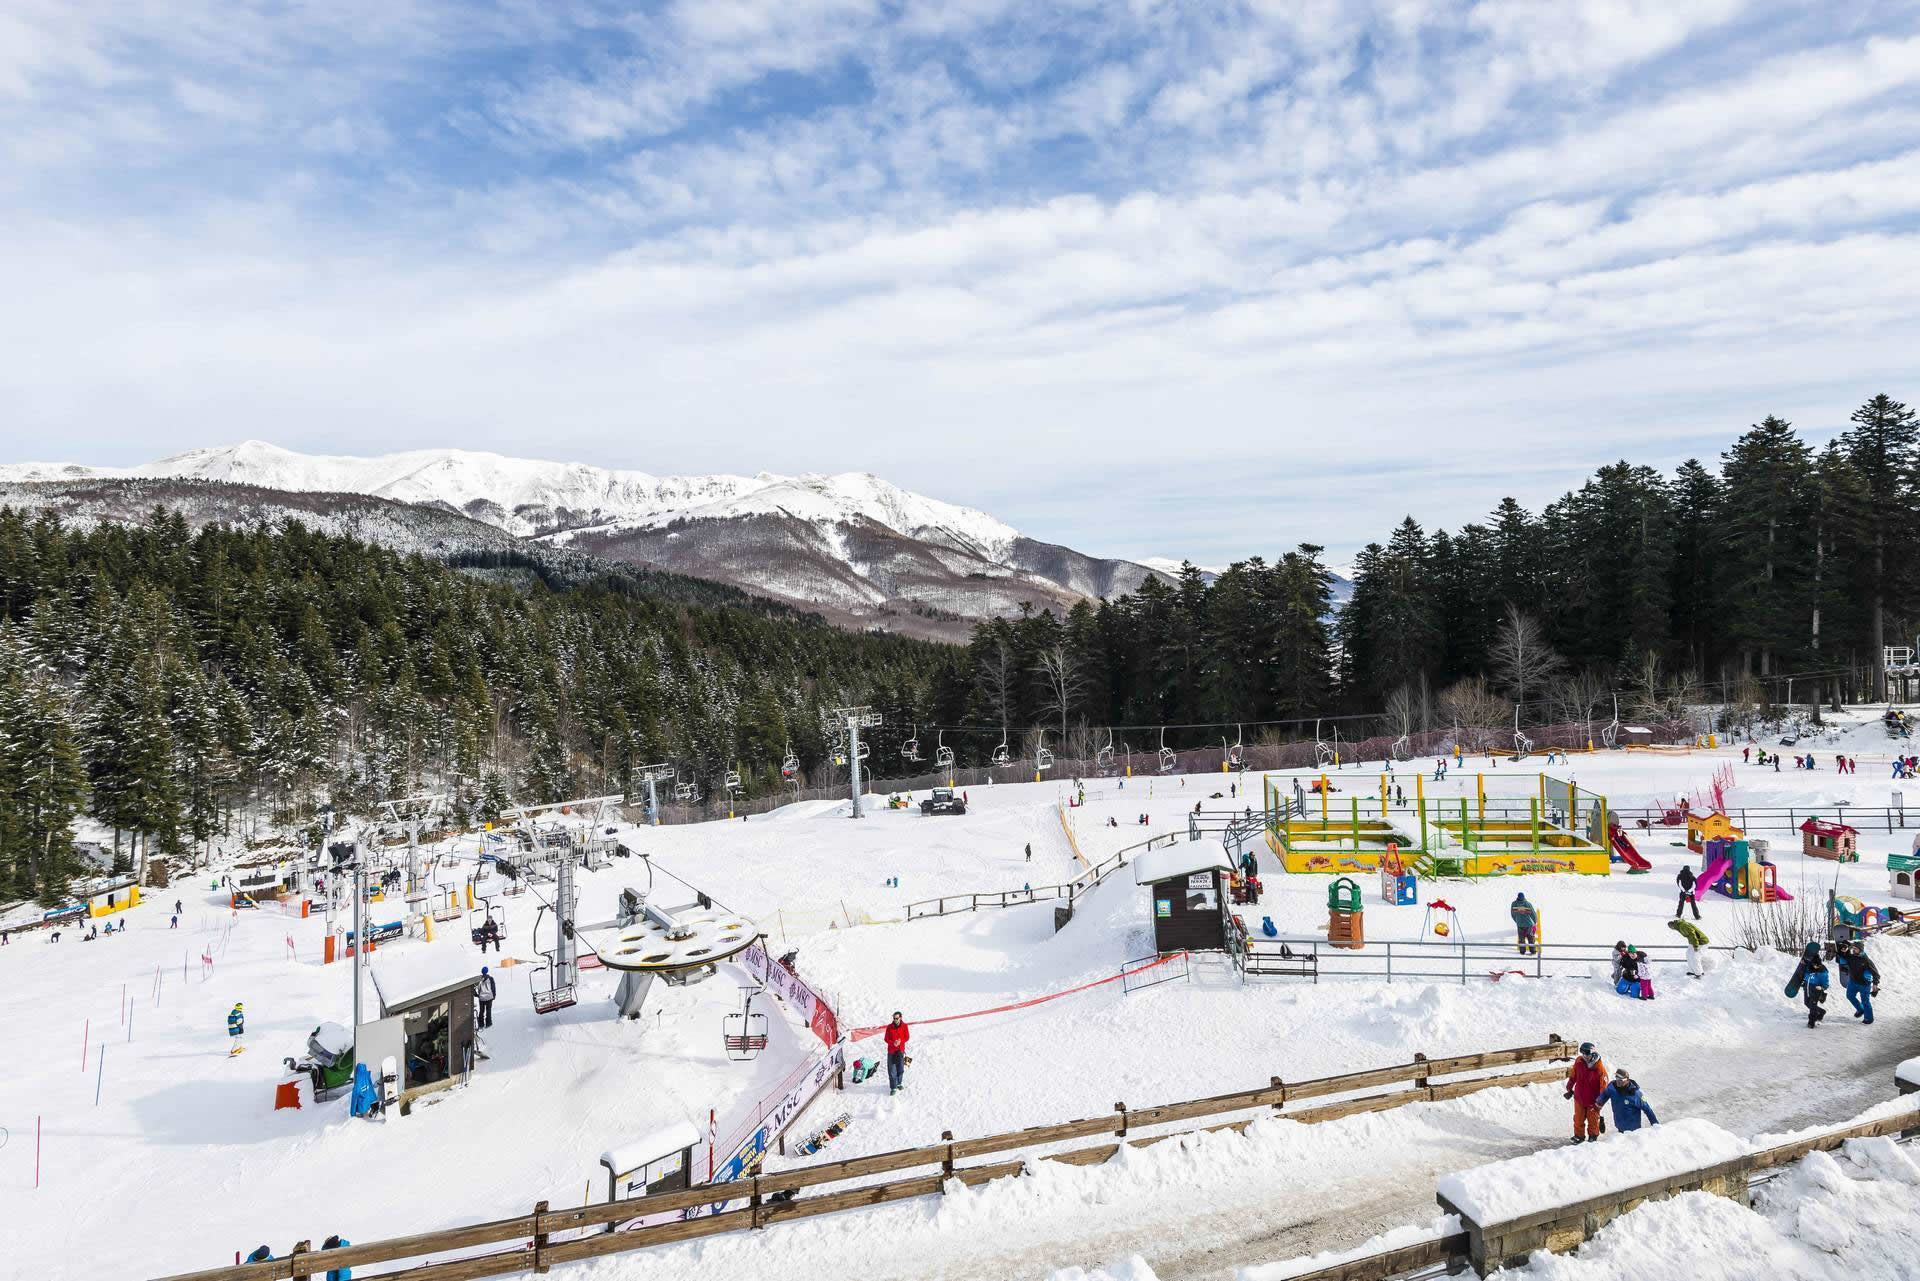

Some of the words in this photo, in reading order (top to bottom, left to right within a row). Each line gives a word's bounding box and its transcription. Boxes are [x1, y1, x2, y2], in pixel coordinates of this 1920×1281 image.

[750, 950, 762, 967] MSC
[773, 966, 786, 987] MSC
[796, 986, 810, 1008] MSC
[773, 1087, 802, 1131] MSC
